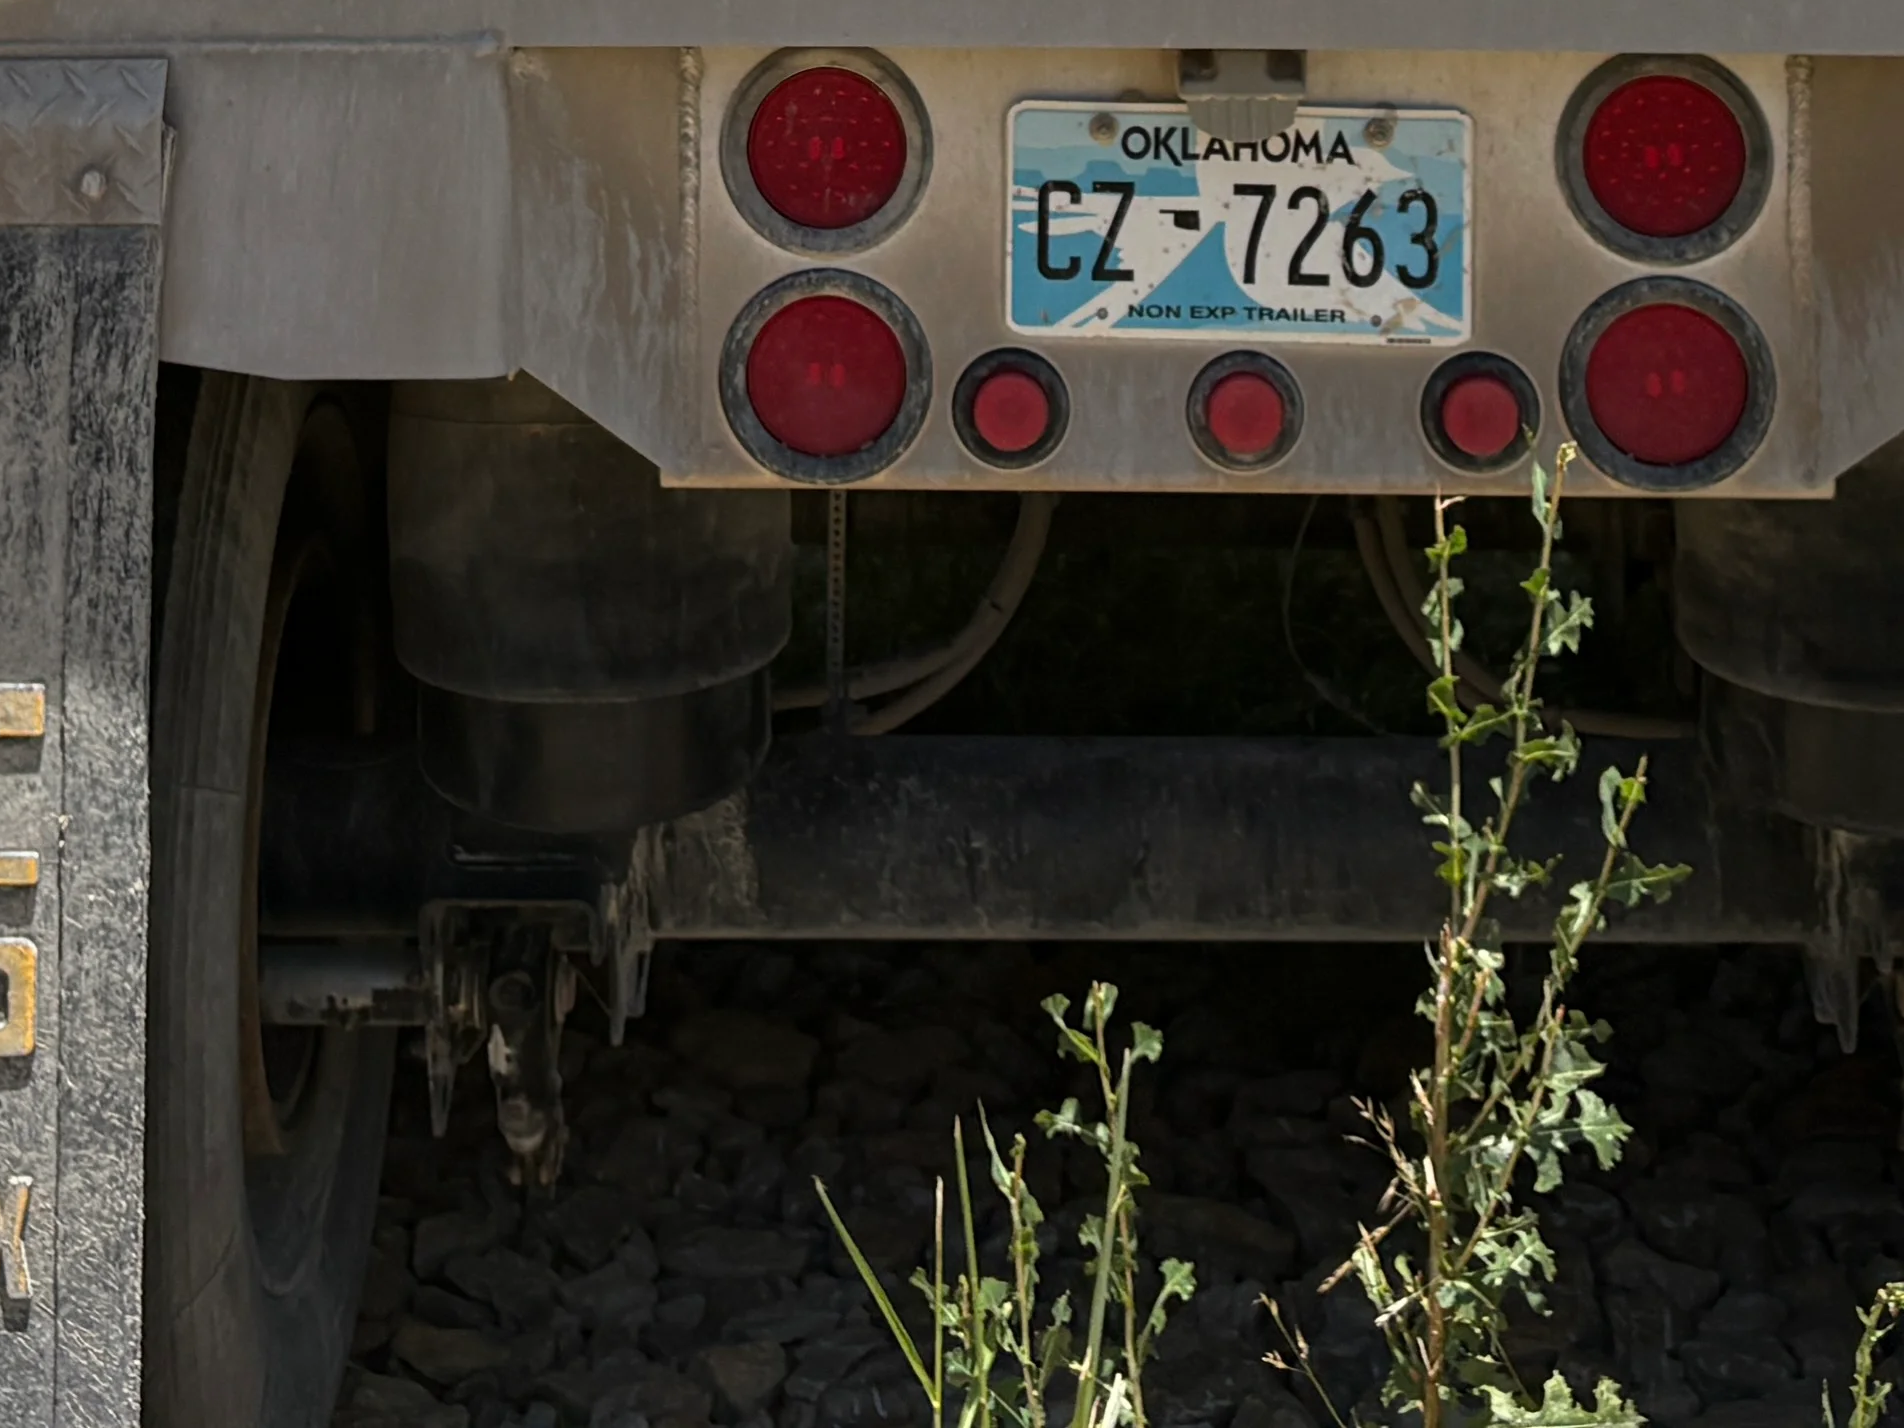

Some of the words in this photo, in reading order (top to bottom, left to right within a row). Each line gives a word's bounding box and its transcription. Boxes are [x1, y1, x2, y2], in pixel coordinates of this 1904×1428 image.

[1120, 125, 1356, 167] OKLAHOMA
[1232, 182, 1440, 290] 7263
[1127, 304, 1182, 320] NON
[1188, 304, 1237, 322] EXP
[1242, 305, 1347, 324] TRAILER
